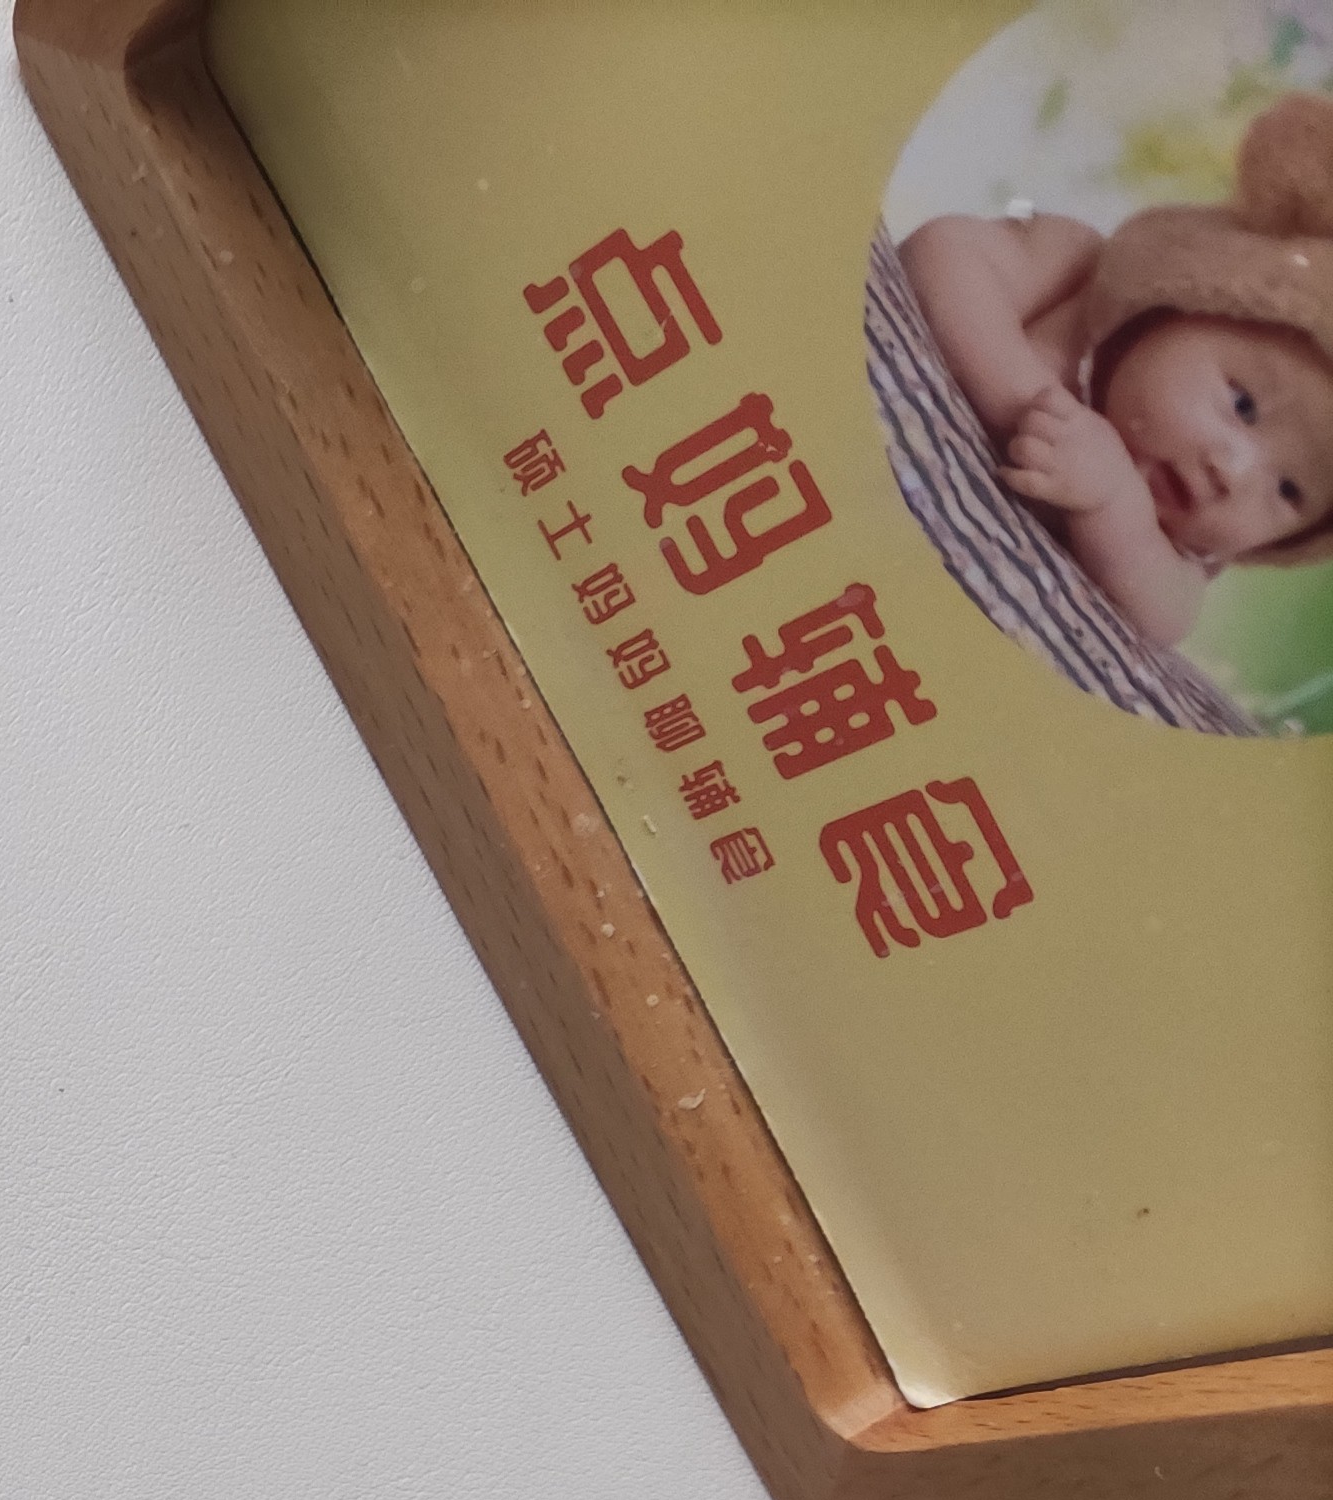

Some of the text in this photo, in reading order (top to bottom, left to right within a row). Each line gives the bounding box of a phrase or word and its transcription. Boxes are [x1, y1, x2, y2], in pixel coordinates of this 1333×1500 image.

[502, 429, 776, 885] 硕士妈妈聊辅食
[523, 227, 1035, 958] 点妈辅食
